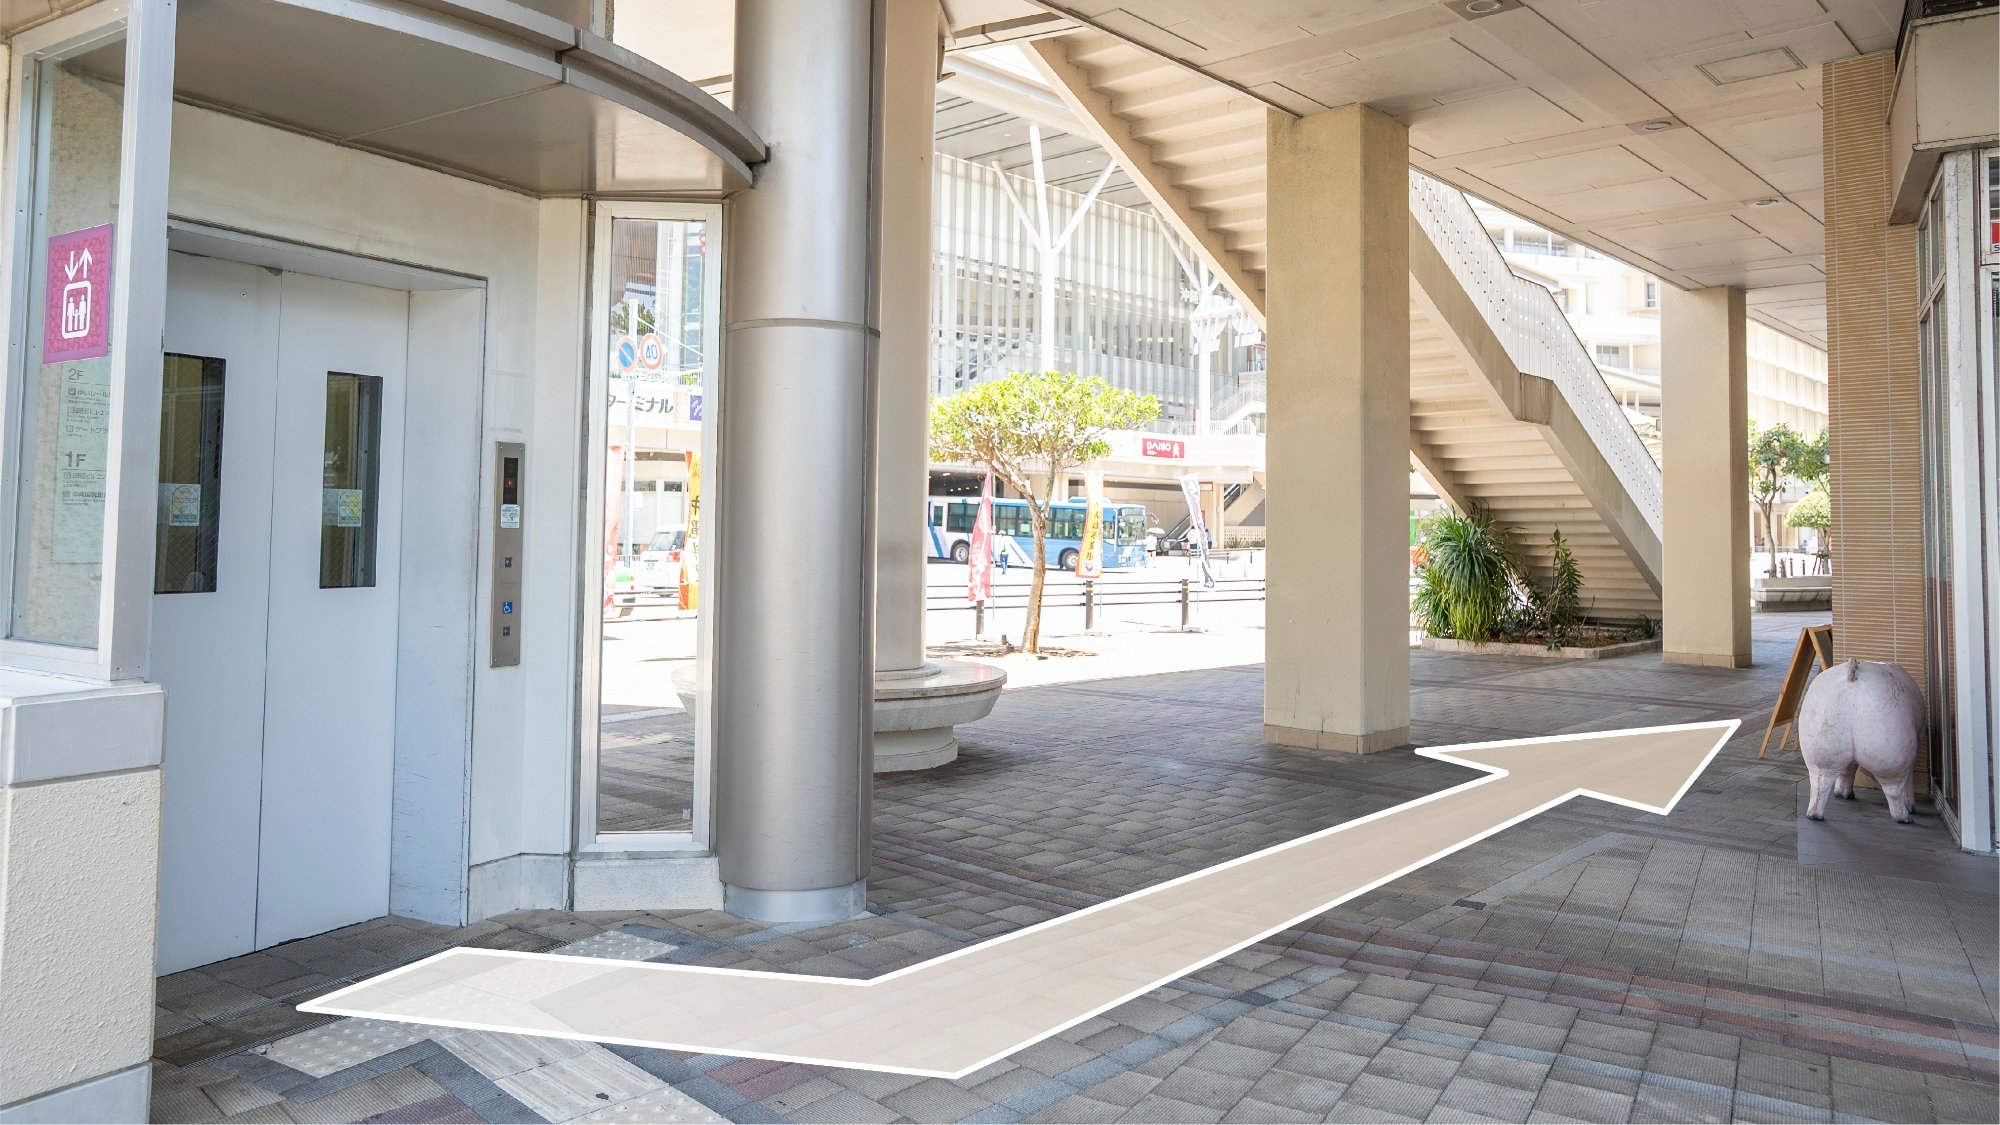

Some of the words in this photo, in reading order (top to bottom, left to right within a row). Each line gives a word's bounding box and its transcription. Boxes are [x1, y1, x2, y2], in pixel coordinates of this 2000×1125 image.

[645, 344, 658, 360] 40
[68, 368, 85, 381] 2F
[65, 450, 86, 467] 1F
